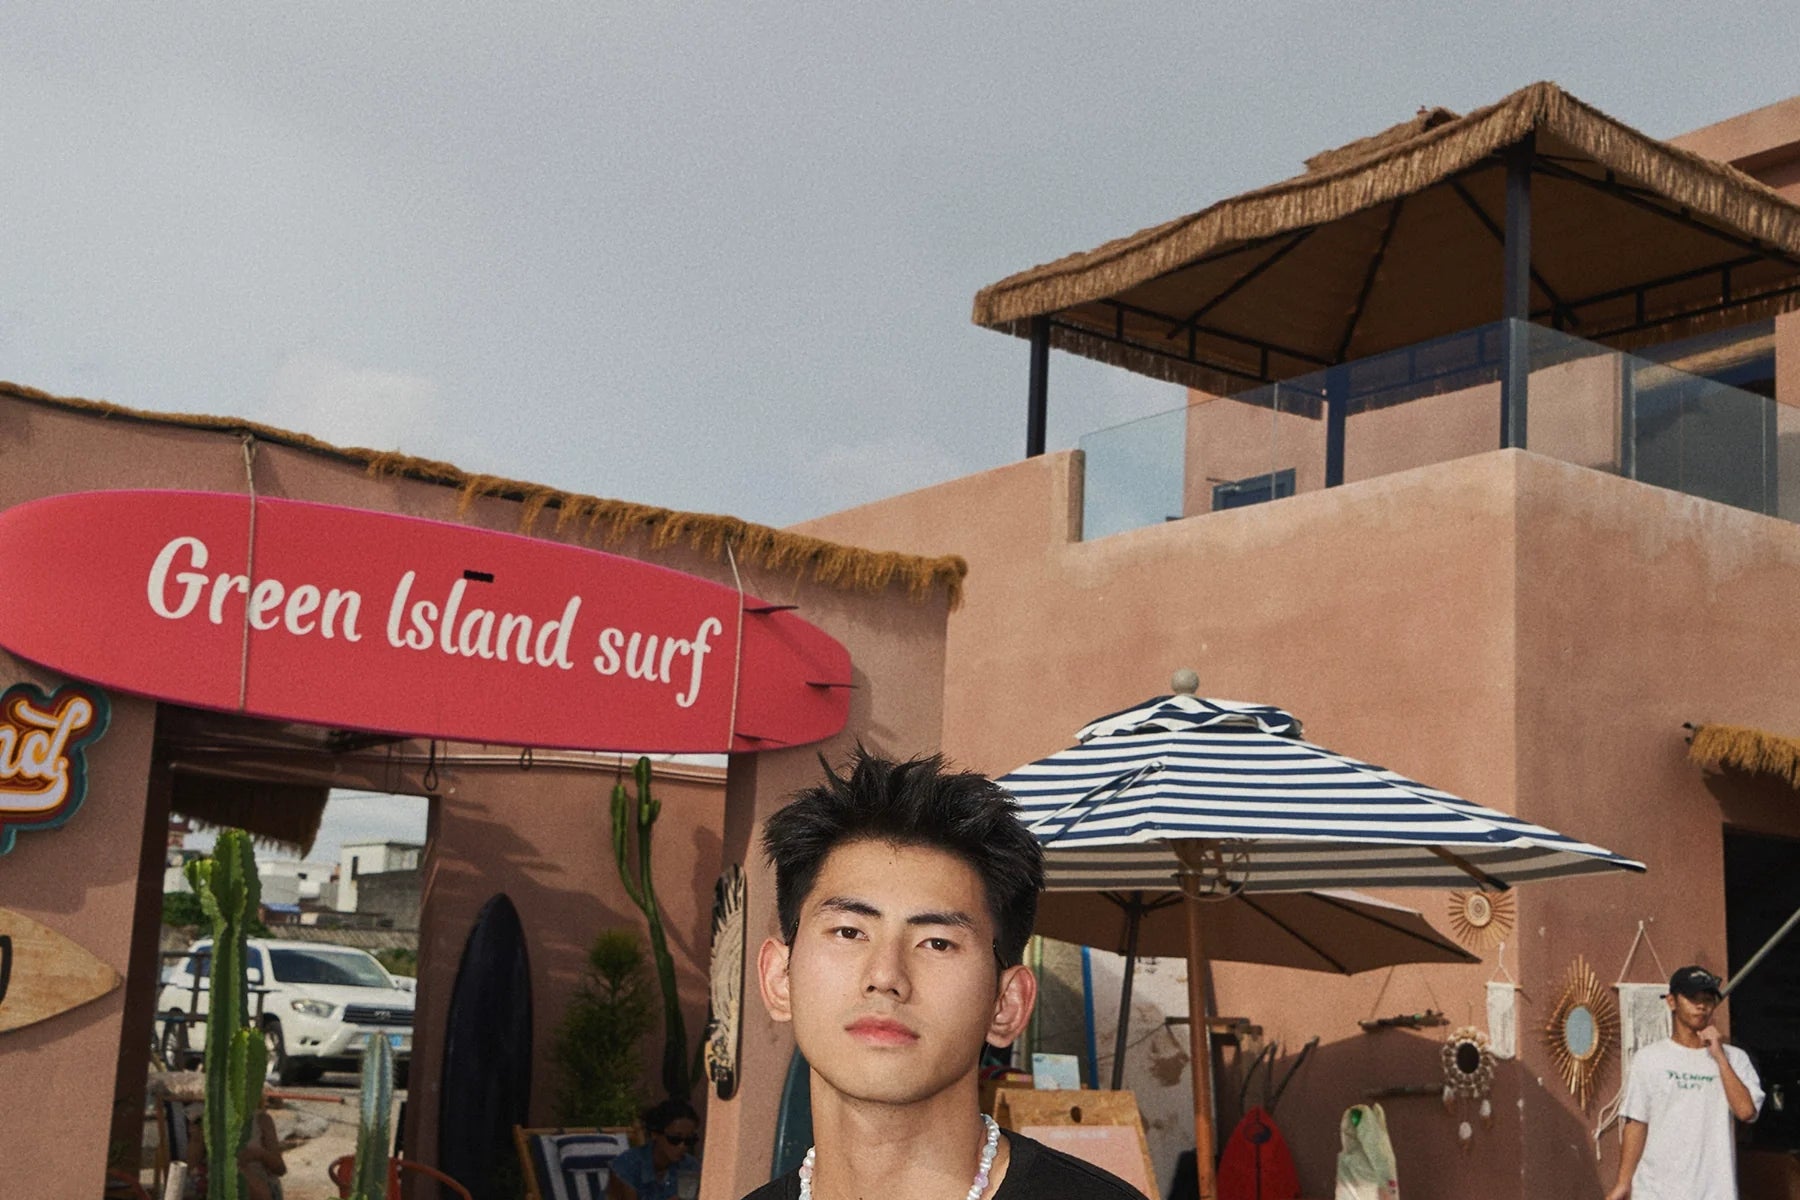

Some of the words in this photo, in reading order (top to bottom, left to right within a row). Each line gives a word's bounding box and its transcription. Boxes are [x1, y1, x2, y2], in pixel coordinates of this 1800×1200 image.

[147, 536, 362, 642] Green
[387, 570, 582, 670] Island
[593, 617, 722, 708] surf
